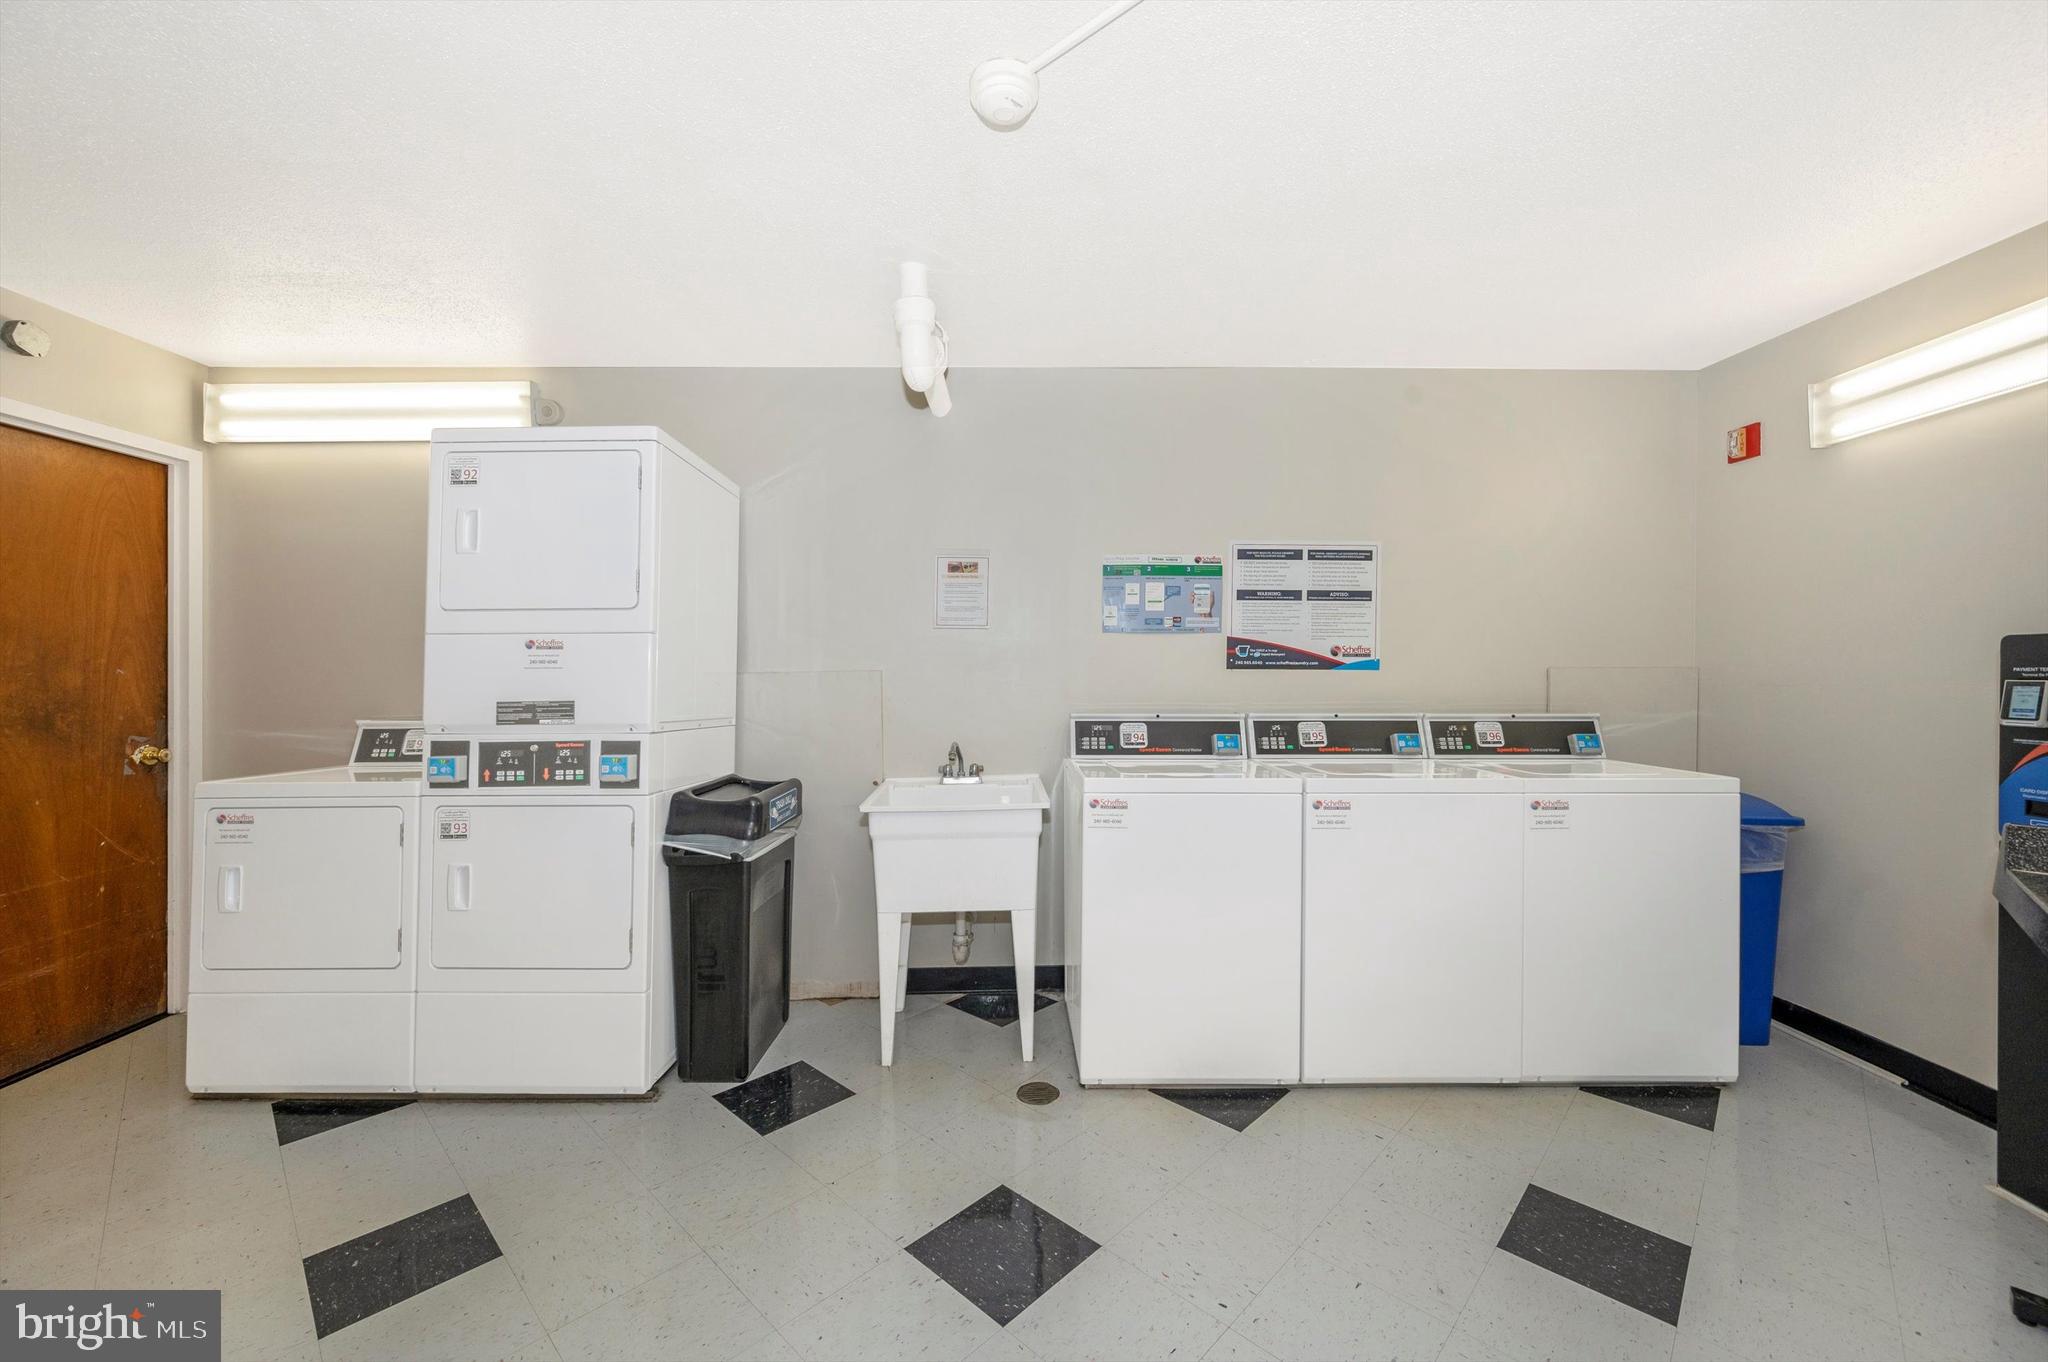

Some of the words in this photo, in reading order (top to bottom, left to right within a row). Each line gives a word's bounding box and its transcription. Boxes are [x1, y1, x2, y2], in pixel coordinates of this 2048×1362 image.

[463, 469, 477, 480] 92
[1342, 645, 1371, 654] Scheffres
[1133, 733, 1145, 742] 94
[1312, 732, 1324, 740] 95
[1489, 732, 1501, 740] 96
[453, 823, 467, 834] 93
